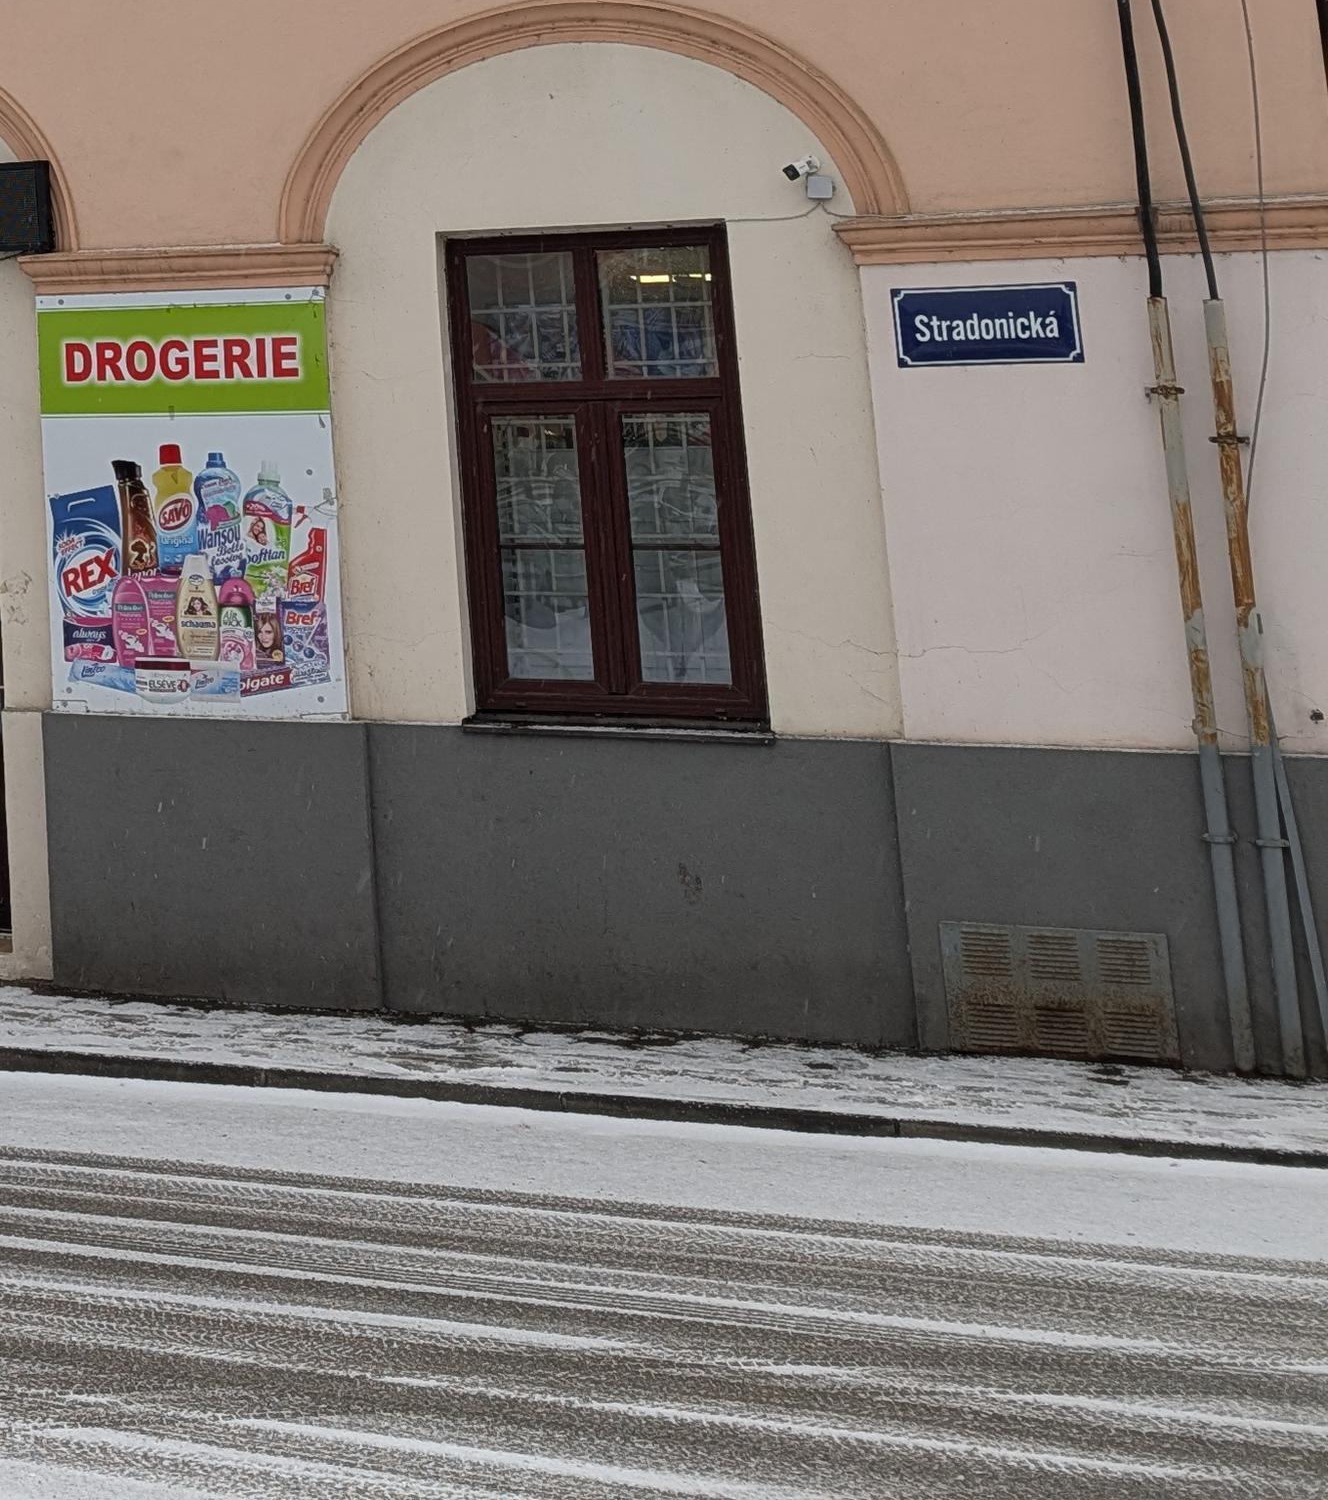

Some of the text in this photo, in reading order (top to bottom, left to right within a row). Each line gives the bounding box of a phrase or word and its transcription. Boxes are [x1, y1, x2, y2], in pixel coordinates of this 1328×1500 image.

[914, 310, 1060, 342] Stradonická
[64, 337, 300, 382] DROGERIE
[162, 503, 189, 525] SAVO
[62, 547, 119, 598] REX
[291, 578, 314, 596] Bref
[181, 619, 216, 629] schauma
[285, 611, 318, 625] Bref
[72, 627, 107, 642] always
[240, 673, 284, 692] olgate
